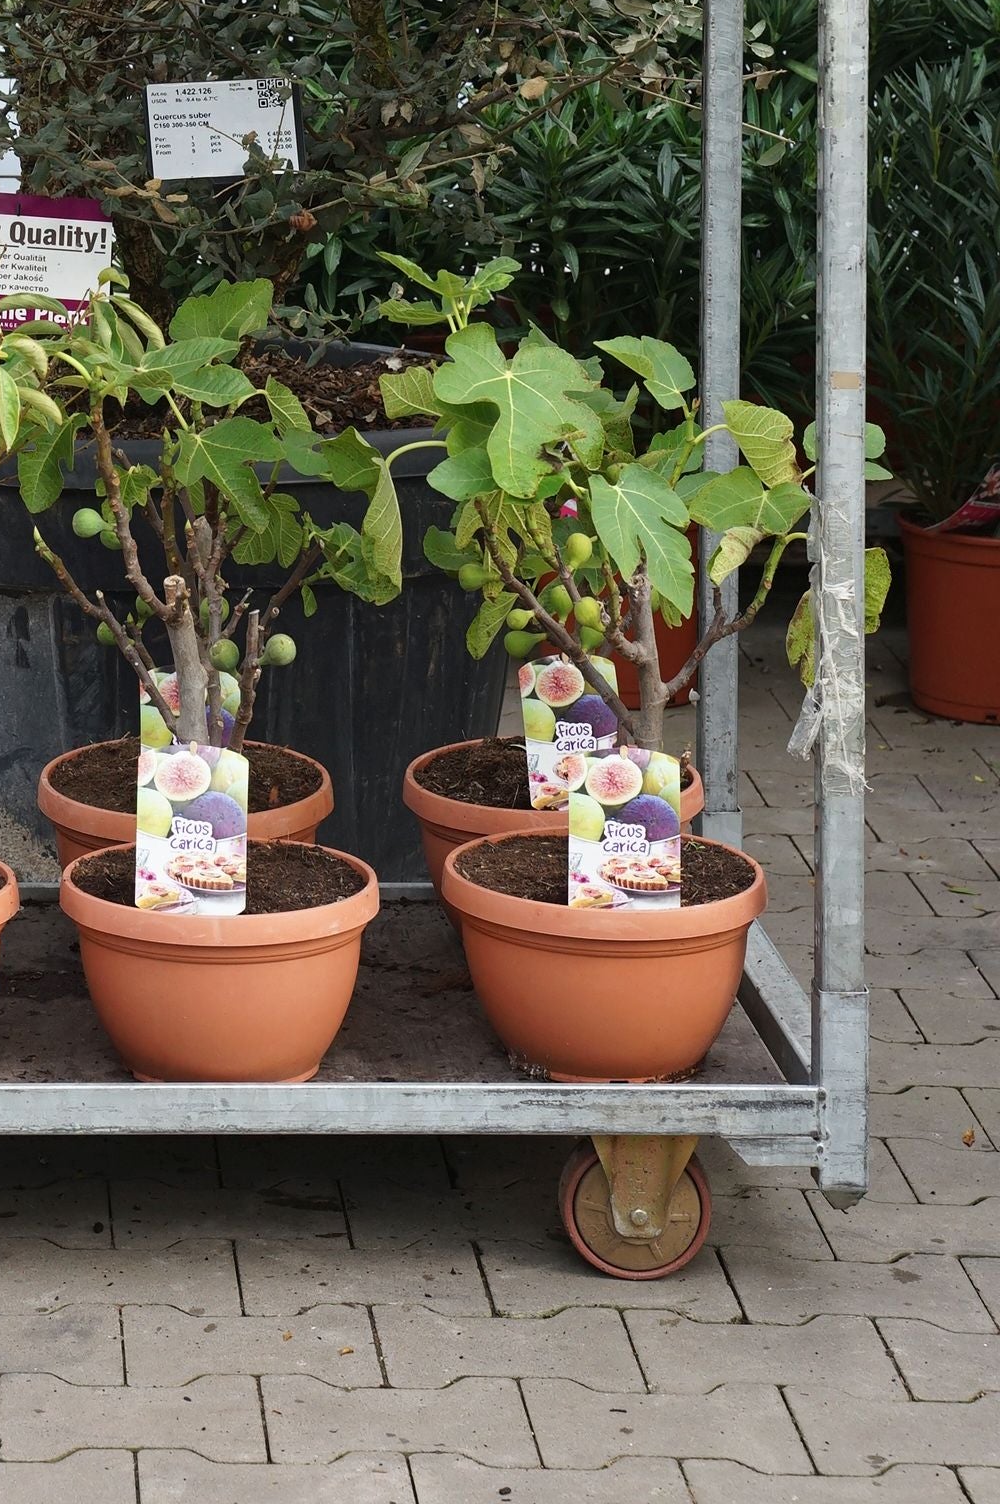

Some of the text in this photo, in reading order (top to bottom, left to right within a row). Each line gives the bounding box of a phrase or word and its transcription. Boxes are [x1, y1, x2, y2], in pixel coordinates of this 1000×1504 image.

[175, 87, 212, 95] 1.422.126
[153, 113, 187, 121] Quercus
[9, 220, 107, 253] Quality!
[13, 252, 46, 262] Qualität
[11, 262, 48, 273] Kwaliteit
[13, 272, 44, 282] Jakość
[9, 284, 49, 293] качество
[556, 739, 595, 752] carica
[169, 837, 214, 851] carica
[602, 840, 647, 853] carica
